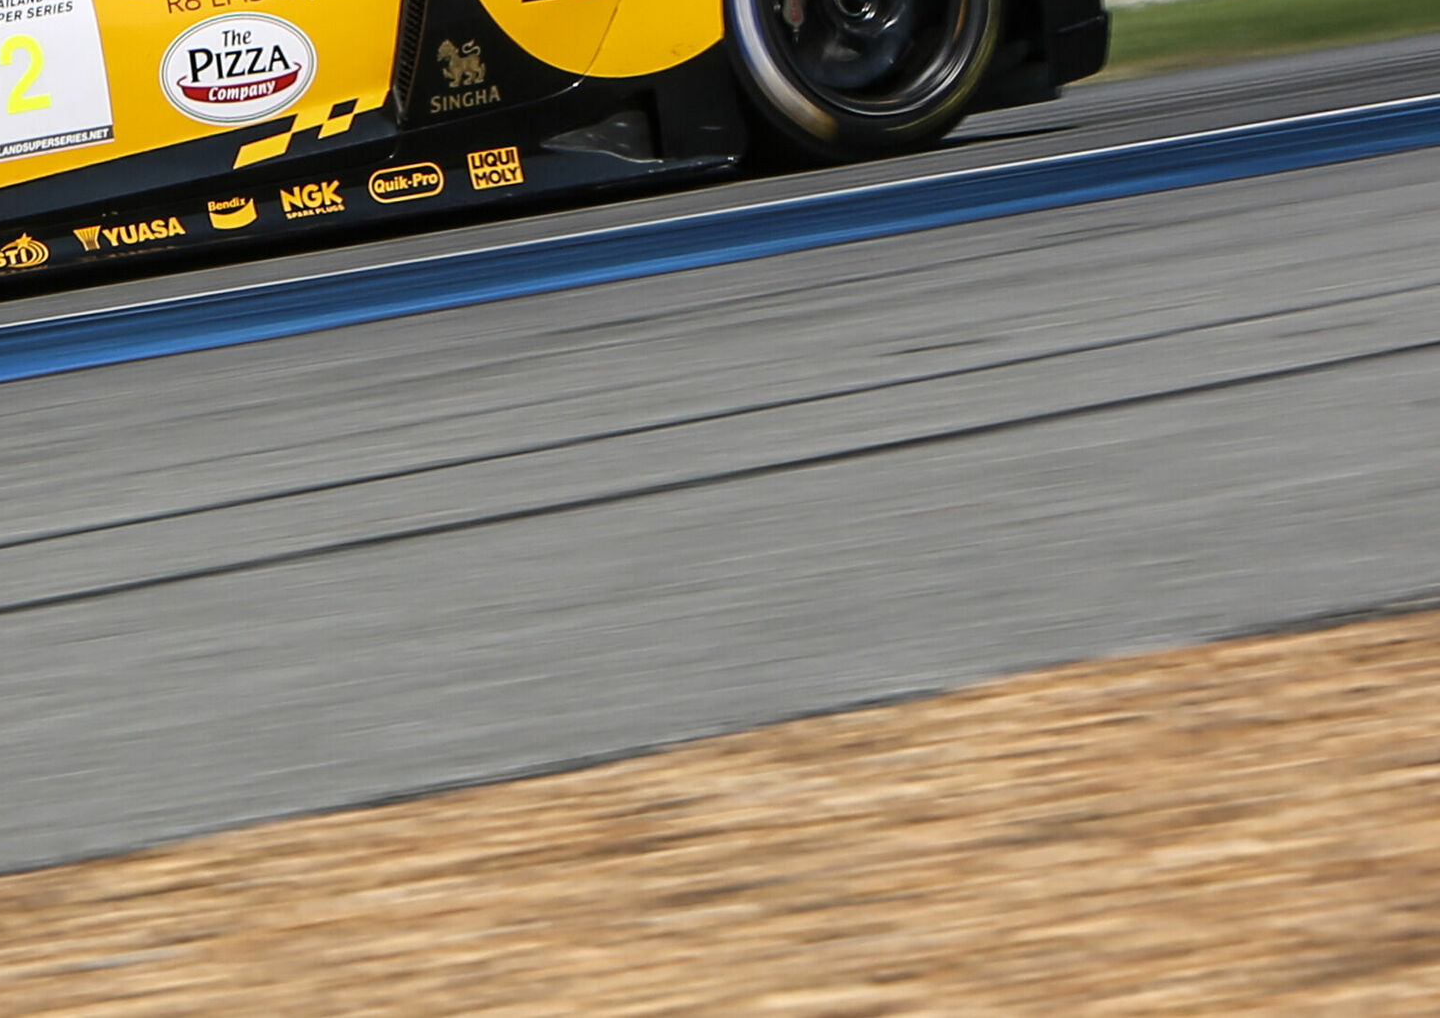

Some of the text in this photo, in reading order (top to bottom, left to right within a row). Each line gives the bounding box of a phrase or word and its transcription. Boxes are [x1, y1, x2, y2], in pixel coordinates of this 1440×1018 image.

[27, 1, 73, 18] SERIES
[222, 30, 252, 47] The
[188, 45, 291, 83] PIZZA
[208, 80, 276, 102] Company
[430, 85, 501, 113] SINGHA
[472, 150, 516, 169] LIQUI
[373, 171, 439, 195] Quik-Pro
[475, 168, 519, 185] MOLY
[207, 196, 246, 212] Bendix
[280, 180, 344, 212] NGK
[285, 203, 346, 220] SPARK PLUGS
[102, 216, 186, 247] YUASA
